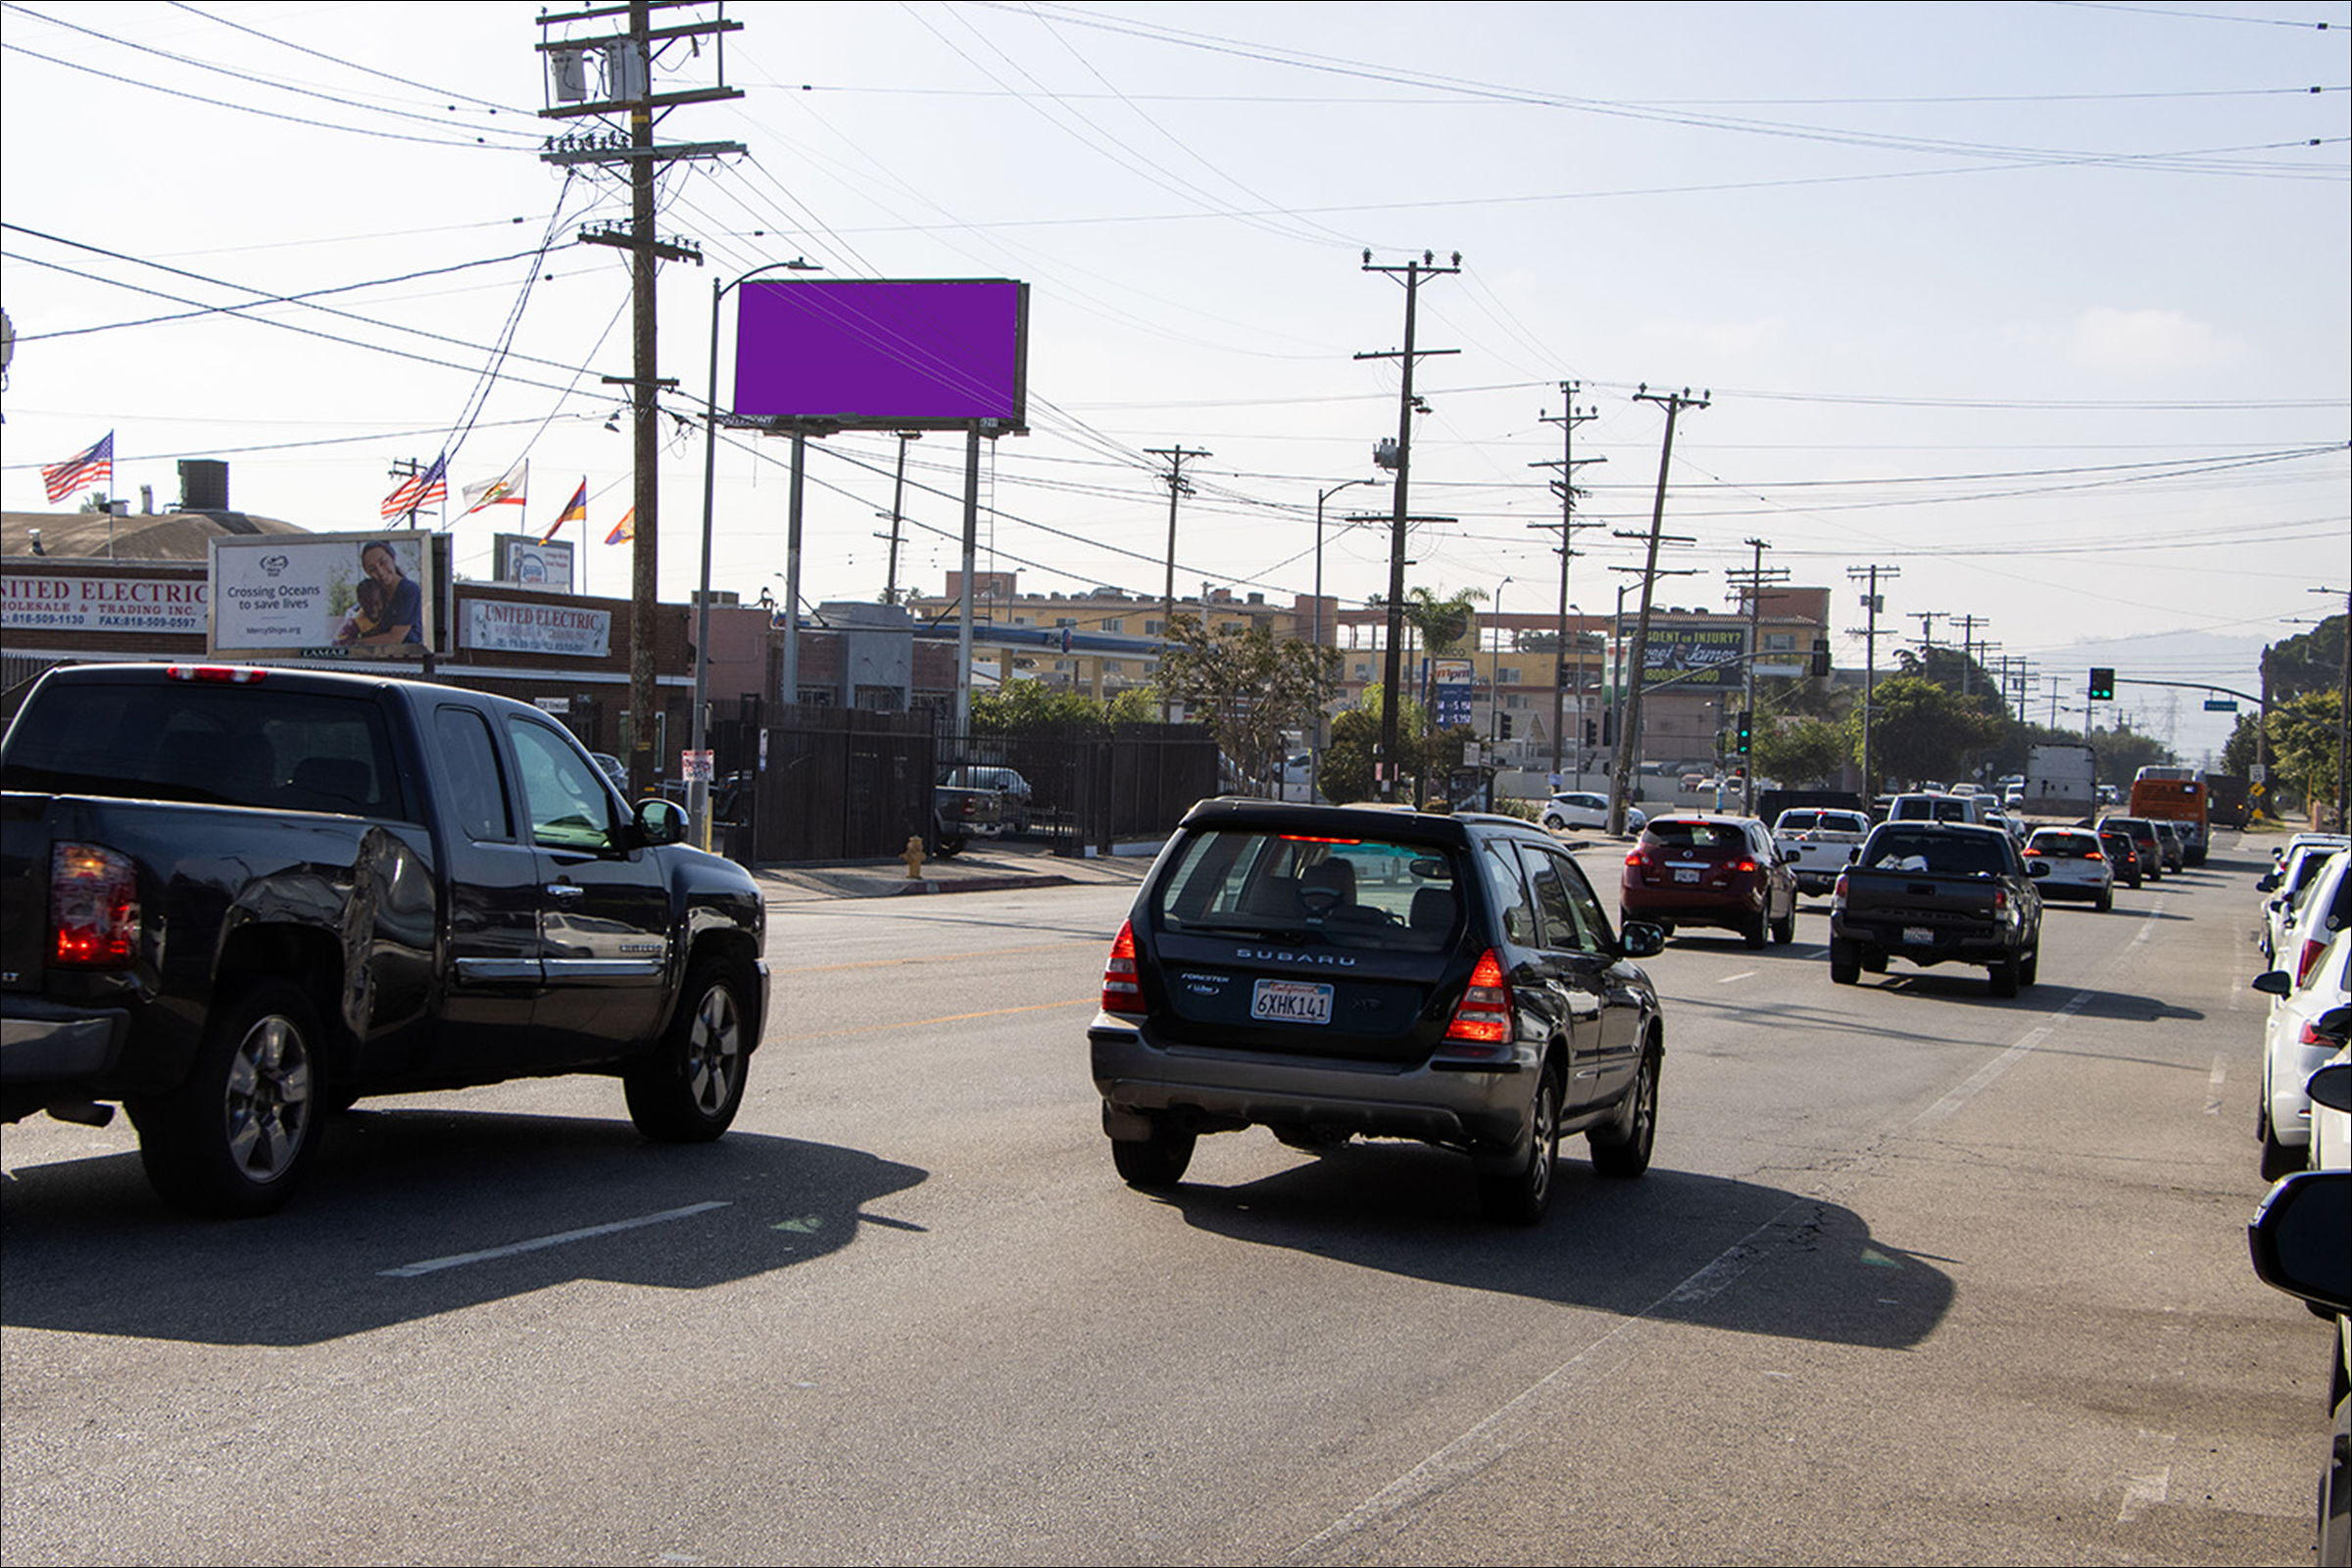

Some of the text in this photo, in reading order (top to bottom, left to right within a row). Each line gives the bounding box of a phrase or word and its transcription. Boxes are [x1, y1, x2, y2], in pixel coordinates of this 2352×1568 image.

[80, 580, 208, 604] ELECTRIC
[227, 585, 320, 599] Crossing Oceans
[79, 604, 88, 612] &
[99, 604, 161, 614] TRADING
[169, 606, 196, 615] INC.
[239, 600, 251, 610] to
[282, 598, 309, 608] lives
[12, 612, 84, 624] 818-509-1130
[484, 604, 599, 630] UNITED ELECTRIC
[1693, 632, 1741, 644] INJURY?
[302, 648, 347, 657] LAMAR
[1236, 949, 1356, 966] SUBARU
[1257, 994, 1326, 1017] 6XHK141
